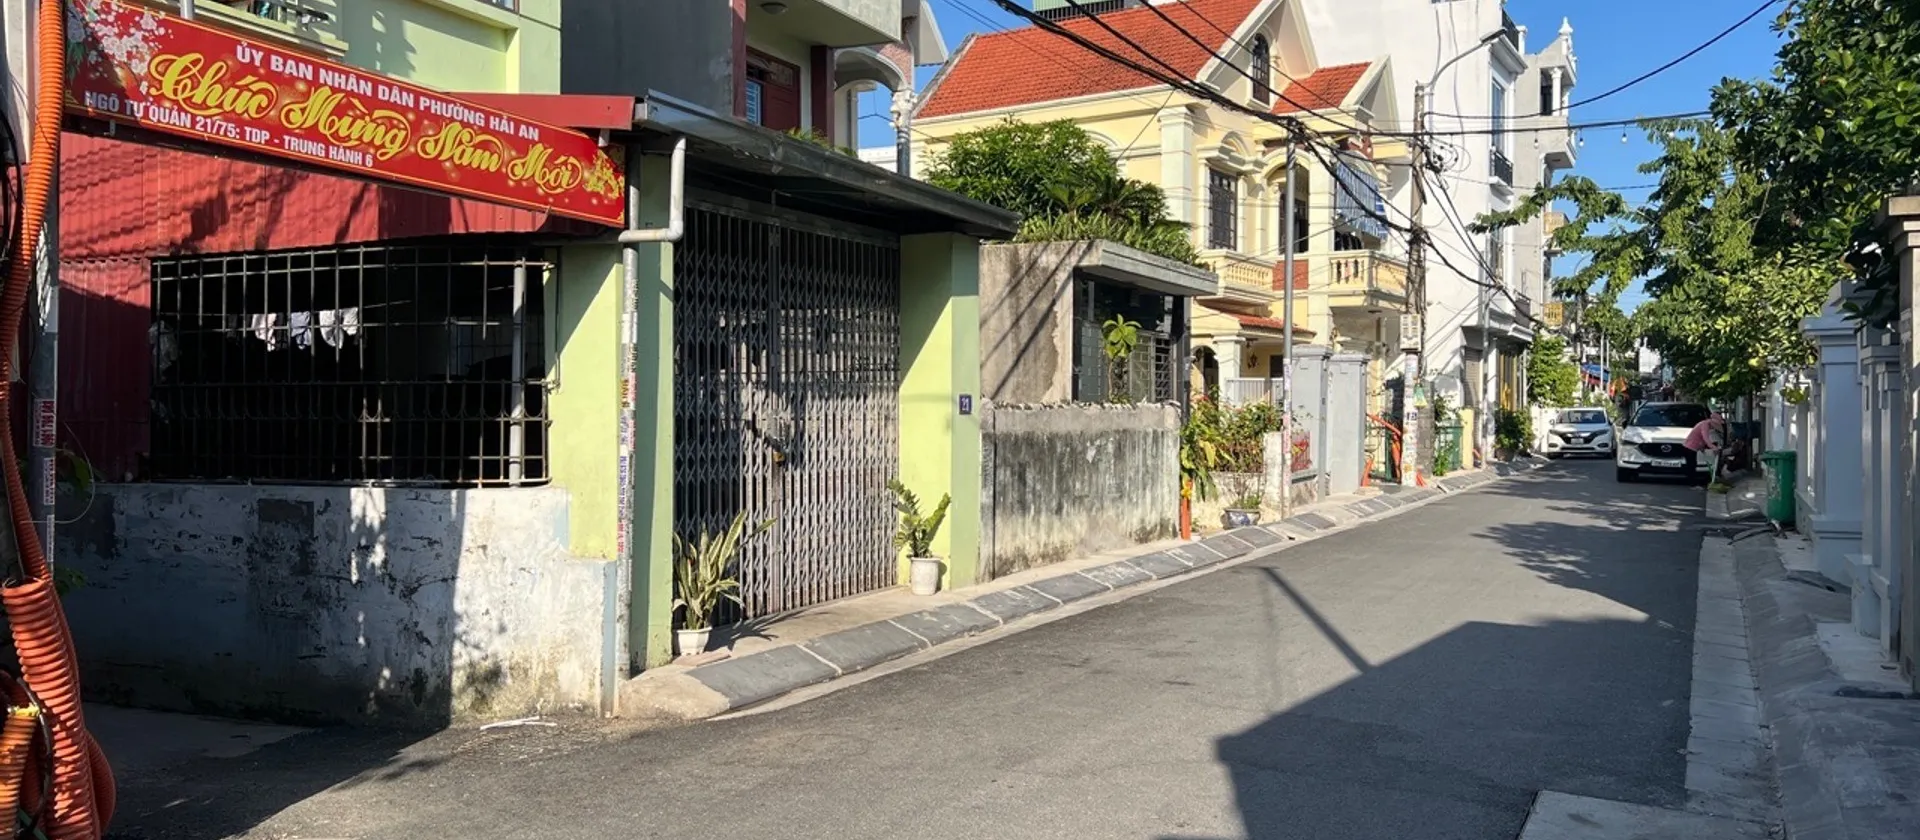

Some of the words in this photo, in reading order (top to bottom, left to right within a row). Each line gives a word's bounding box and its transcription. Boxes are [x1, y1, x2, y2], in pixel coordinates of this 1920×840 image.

[84, 90, 119, 113] NGÕ
[149, 103, 191, 129] QUẢN
[195, 116, 240, 140] 21/75:
[244, 125, 270, 145] TDP
[283, 135, 325, 158] TRUNG
[329, 143, 361, 165] HÀNH
[365, 156, 374, 168] 6
[149, 52, 278, 119] Chúc
[280, 84, 411, 161] Mừng
[507, 142, 582, 194] Mới
[237, 42, 264, 66] ỦY
[271, 54, 313, 80] BAN
[319, 69, 372, 97] NHÂN
[378, 84, 414, 108] DÂN
[419, 98, 485, 127] PHƯỜNG
[489, 115, 514, 135] HẢI
[518, 125, 539, 141] AN
